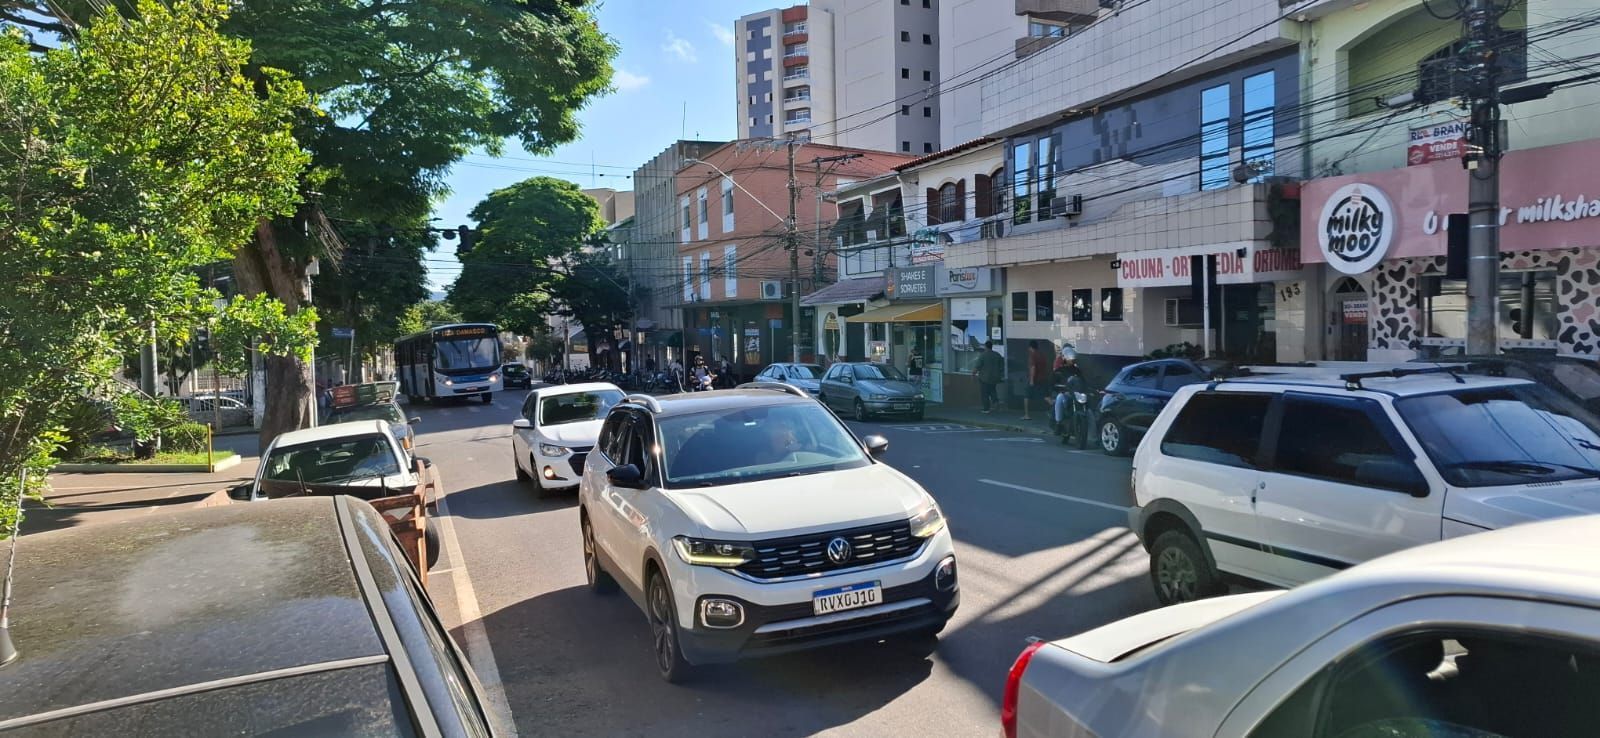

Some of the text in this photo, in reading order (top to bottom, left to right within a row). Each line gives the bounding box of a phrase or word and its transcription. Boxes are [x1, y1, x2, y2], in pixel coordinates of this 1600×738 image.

[1429, 141, 1458, 153] VENDE
[1326, 204, 1384, 237] milky
[1327, 233, 1371, 253] moo
[900, 270, 926, 281] SHAKES E
[1122, 257, 1164, 280] COLUNA
[900, 283, 927, 293] SORVETES
